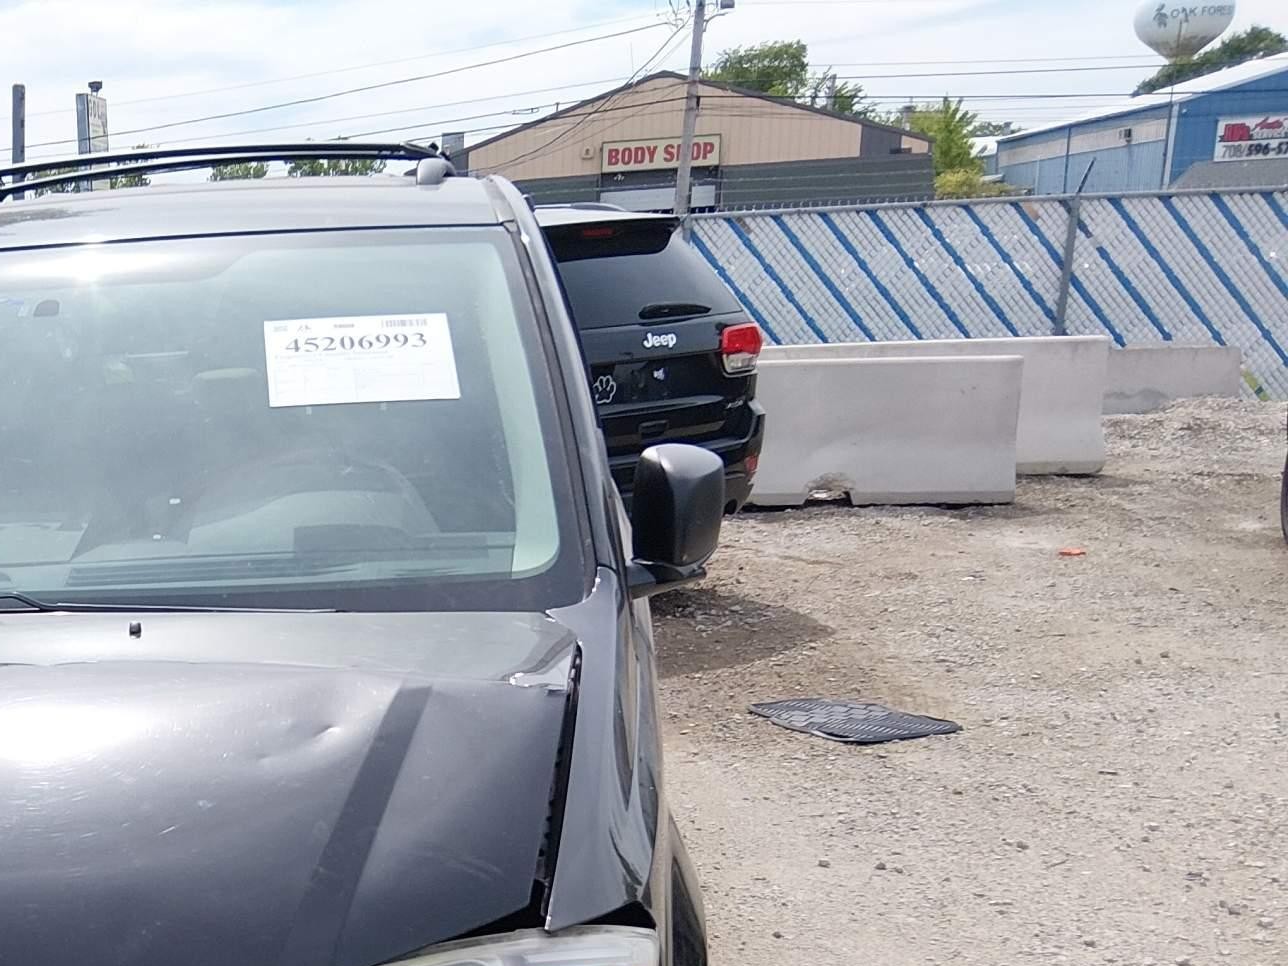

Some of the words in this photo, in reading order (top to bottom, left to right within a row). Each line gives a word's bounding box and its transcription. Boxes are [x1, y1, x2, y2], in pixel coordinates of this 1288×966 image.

[1170, 6, 1198, 19] OAK
[1201, 5, 1234, 17] FORES
[607, 145, 658, 166] BODY
[285, 332, 428, 353] 45206993
[643, 332, 677, 348] Jeep
